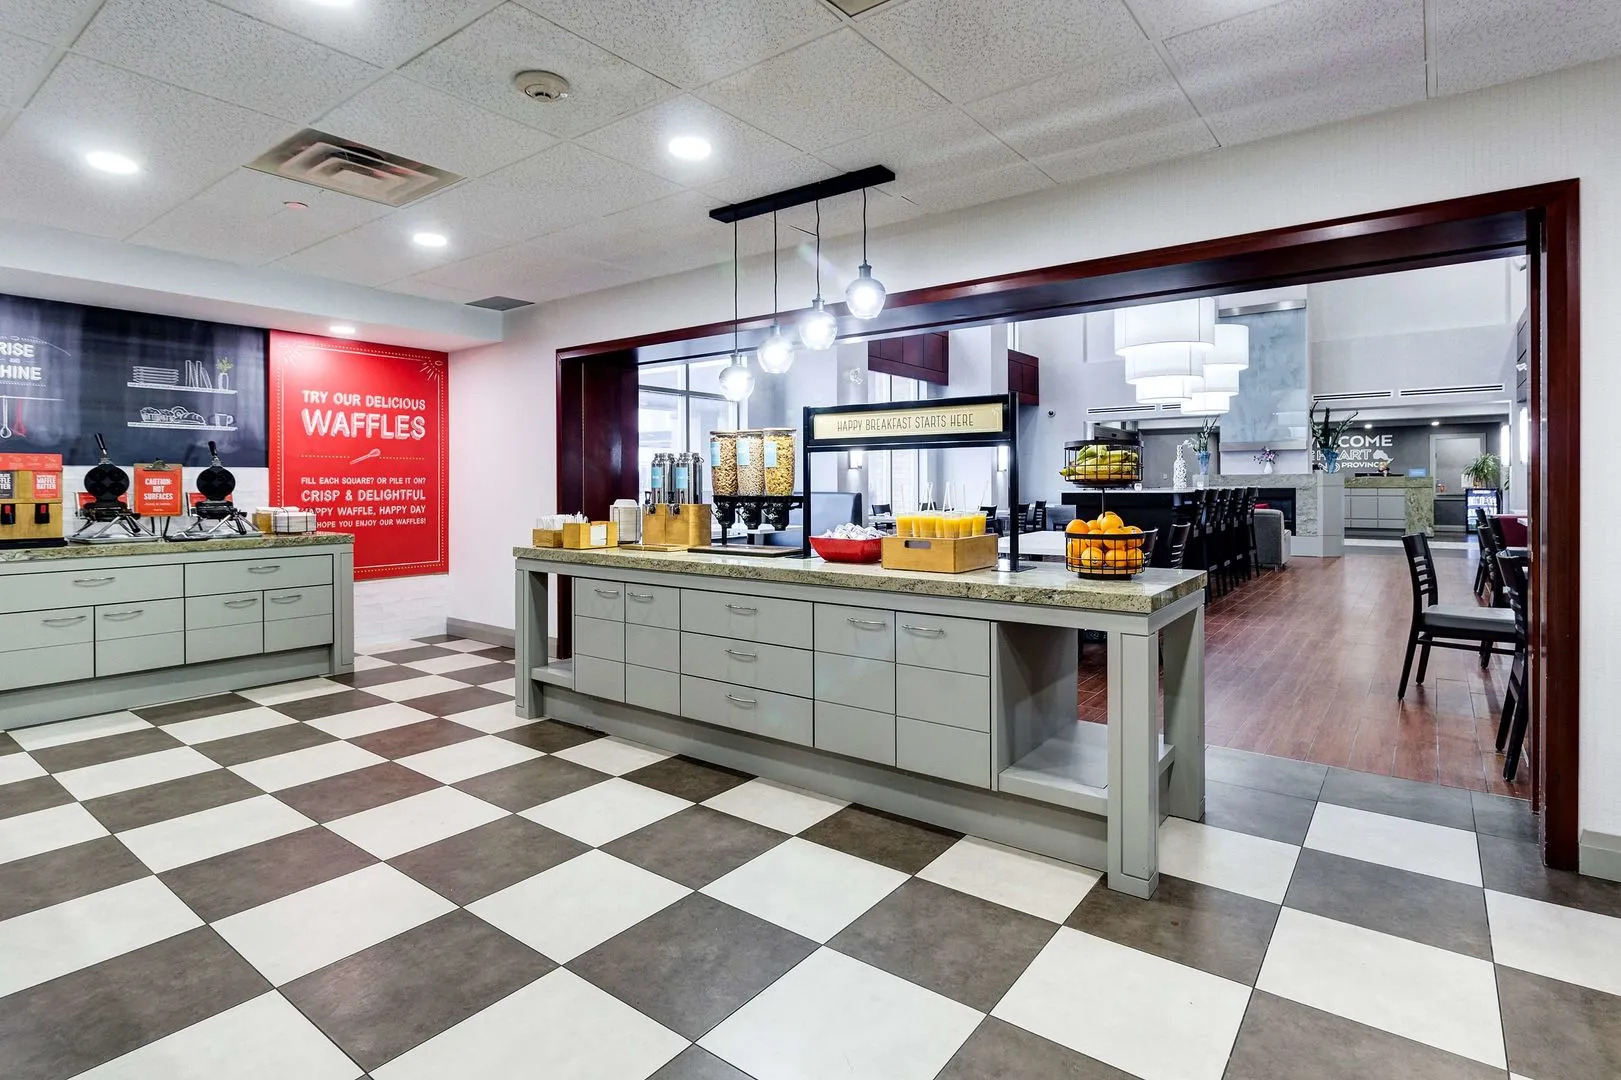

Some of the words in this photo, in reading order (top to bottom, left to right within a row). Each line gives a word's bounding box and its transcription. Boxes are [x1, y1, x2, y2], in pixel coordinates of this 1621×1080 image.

[0, 341, 35, 358] RISE
[301, 390, 329, 404] TRY
[333, 392, 361, 406] OUR
[365, 395, 426, 411] DELICIOUS
[300, 408, 426, 440] WAFFLES
[837, 419, 863, 432] HAPPY
[865, 416, 912, 431] BREAKFAST
[915, 414, 947, 428] STARTS
[950, 413, 974, 427] HERE
[301, 477, 316, 485] FILL
[319, 477, 339, 485] EACH
[342, 477, 374, 485] SQUARE?
[301, 489, 341, 502] CRISP
[345, 489, 353, 501] &
[358, 488, 426, 501] DELIGHTFUL
[337, 506, 376, 516] WAFFLE,
[379, 505, 408, 514] HAPPY
[410, 505, 426, 513] DAY
[355, 519, 377, 527] ENJOY
[380, 518, 394, 526] OUR
[395, 517, 427, 525] WAFFLES!
